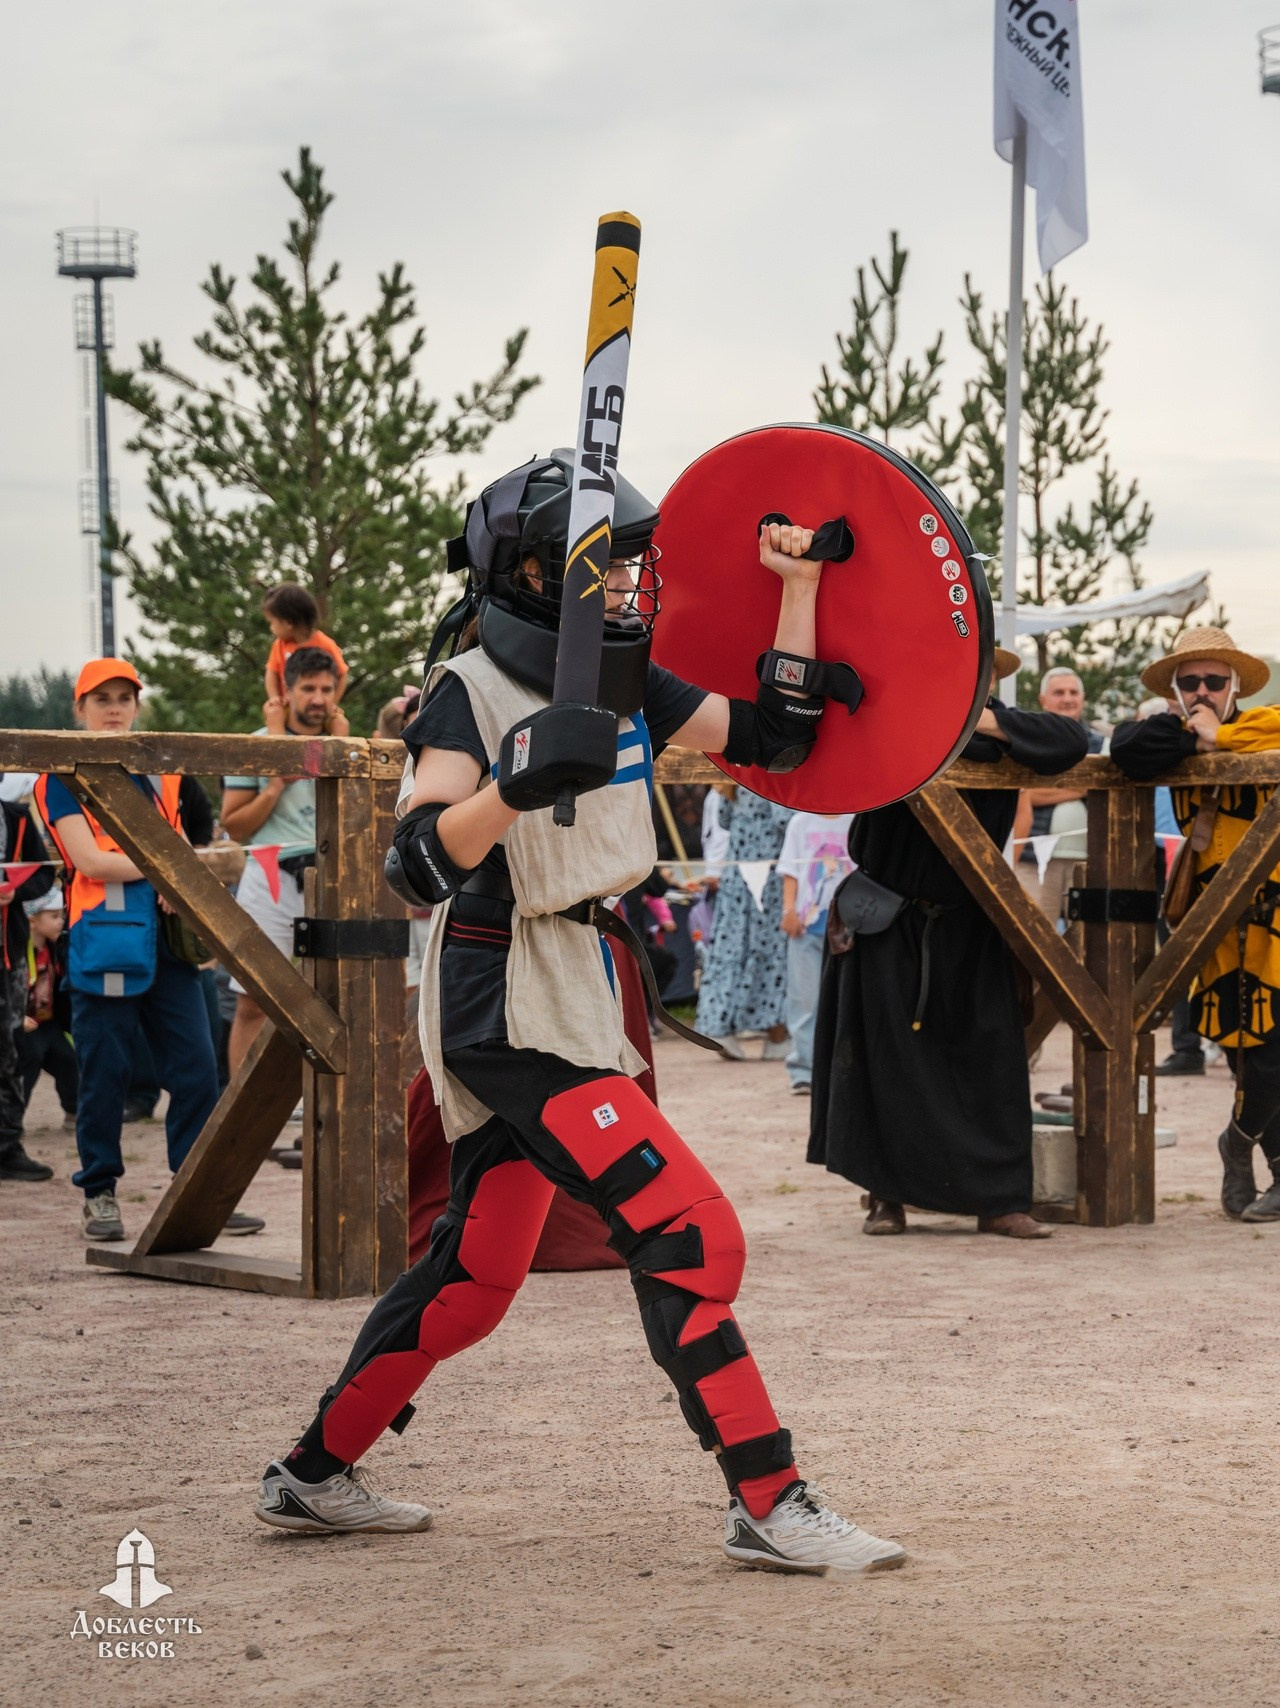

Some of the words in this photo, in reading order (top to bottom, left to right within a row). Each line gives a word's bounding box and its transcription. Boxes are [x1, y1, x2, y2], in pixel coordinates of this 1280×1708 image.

[579, 384, 625, 496] ИСБ
[786, 705, 818, 716] BAUER
[425, 857, 448, 890] BAUER
